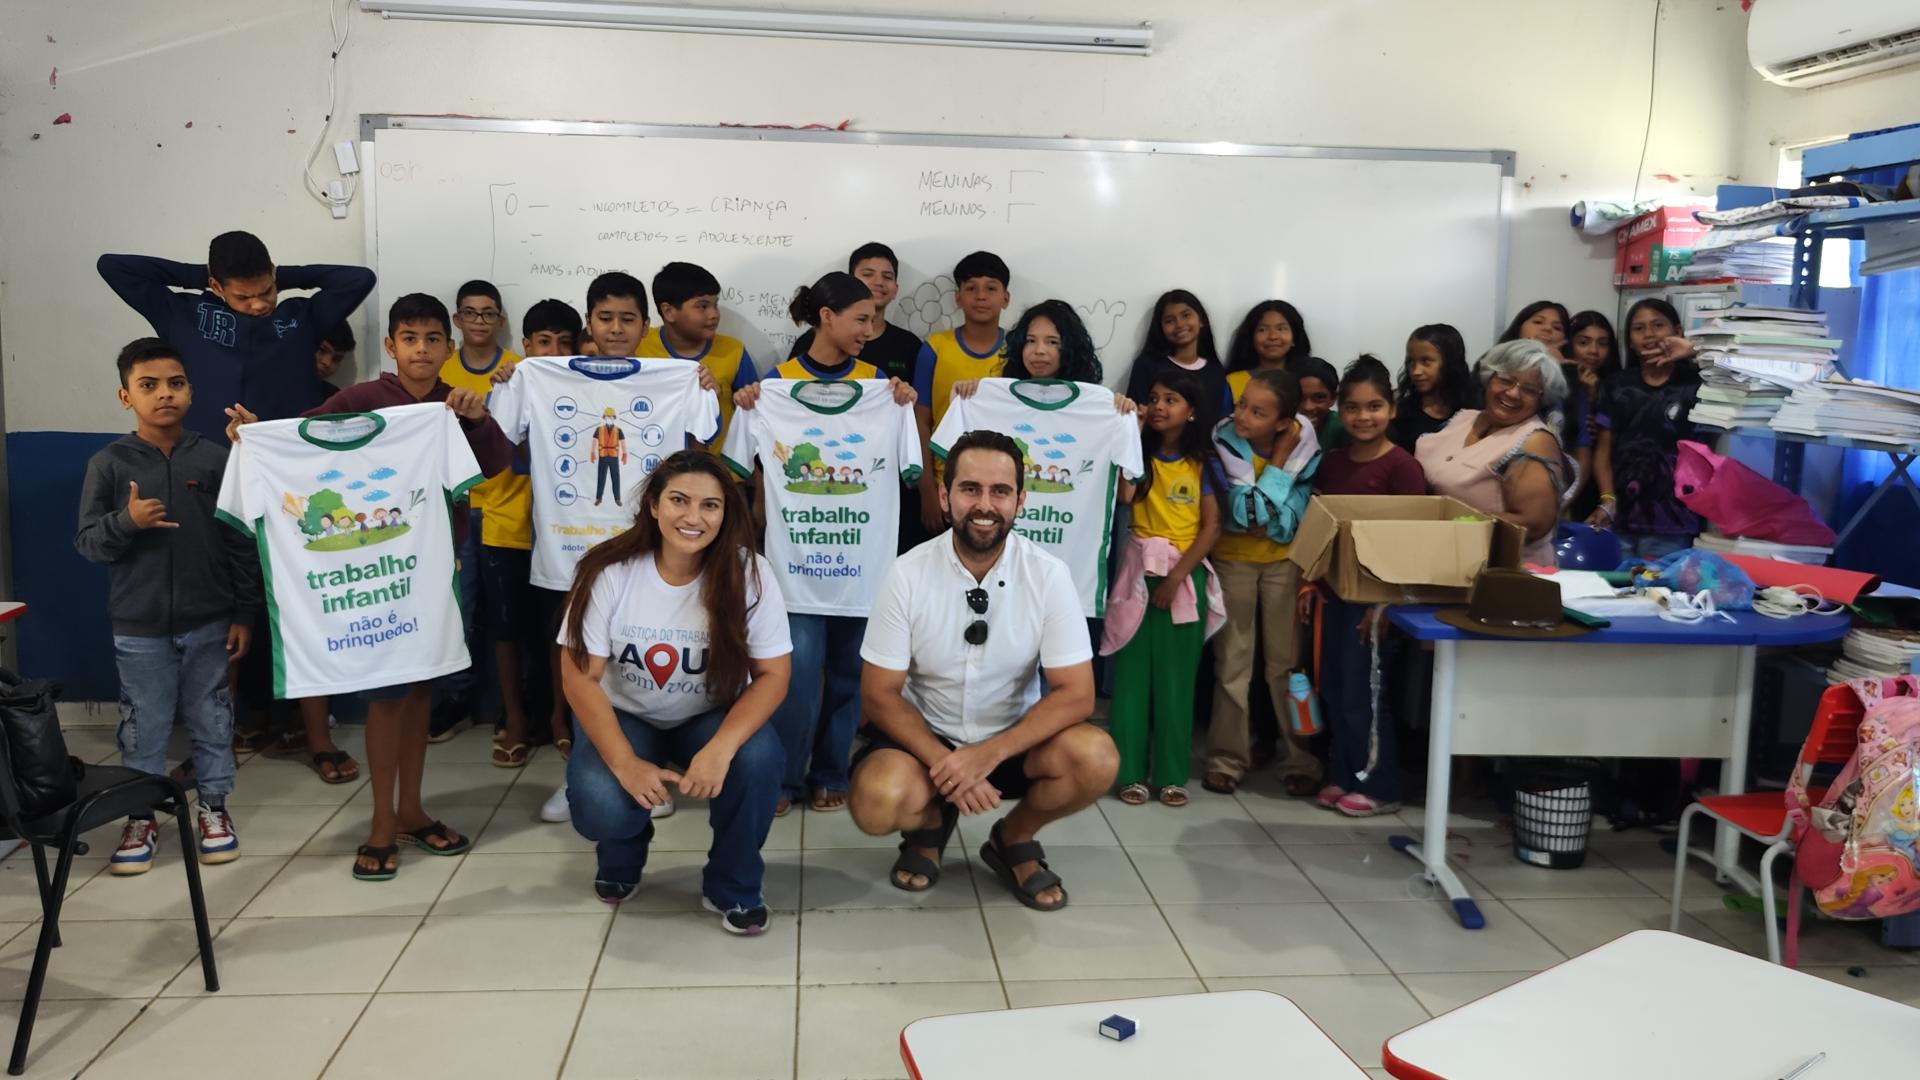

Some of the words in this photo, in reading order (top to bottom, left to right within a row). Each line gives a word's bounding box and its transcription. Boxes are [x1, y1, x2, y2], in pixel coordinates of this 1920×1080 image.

[918, 170, 993, 192] MENINAS
[593, 200, 679, 217] INCOMPLETOS
[711, 197, 788, 220] CRIANÇA
[598, 230, 668, 243] COMPLETOS
[698, 231, 793, 248] ADOLESCENTE
[782, 506, 870, 524] trabalho
[550, 523, 607, 536] Trabalho
[789, 527, 862, 545] infantil
[806, 552, 832, 564] não
[836, 552, 845, 564] é
[306, 555, 418, 590] trabalho
[788, 562, 862, 580] brinquedo!
[321, 577, 411, 614] infantil
[349, 615, 383, 632] não
[388, 610, 398, 624] é
[327, 617, 419, 651] brinquedo!
[621, 624, 657, 642] JUSTIÇA
[660, 628, 673, 641] DO
